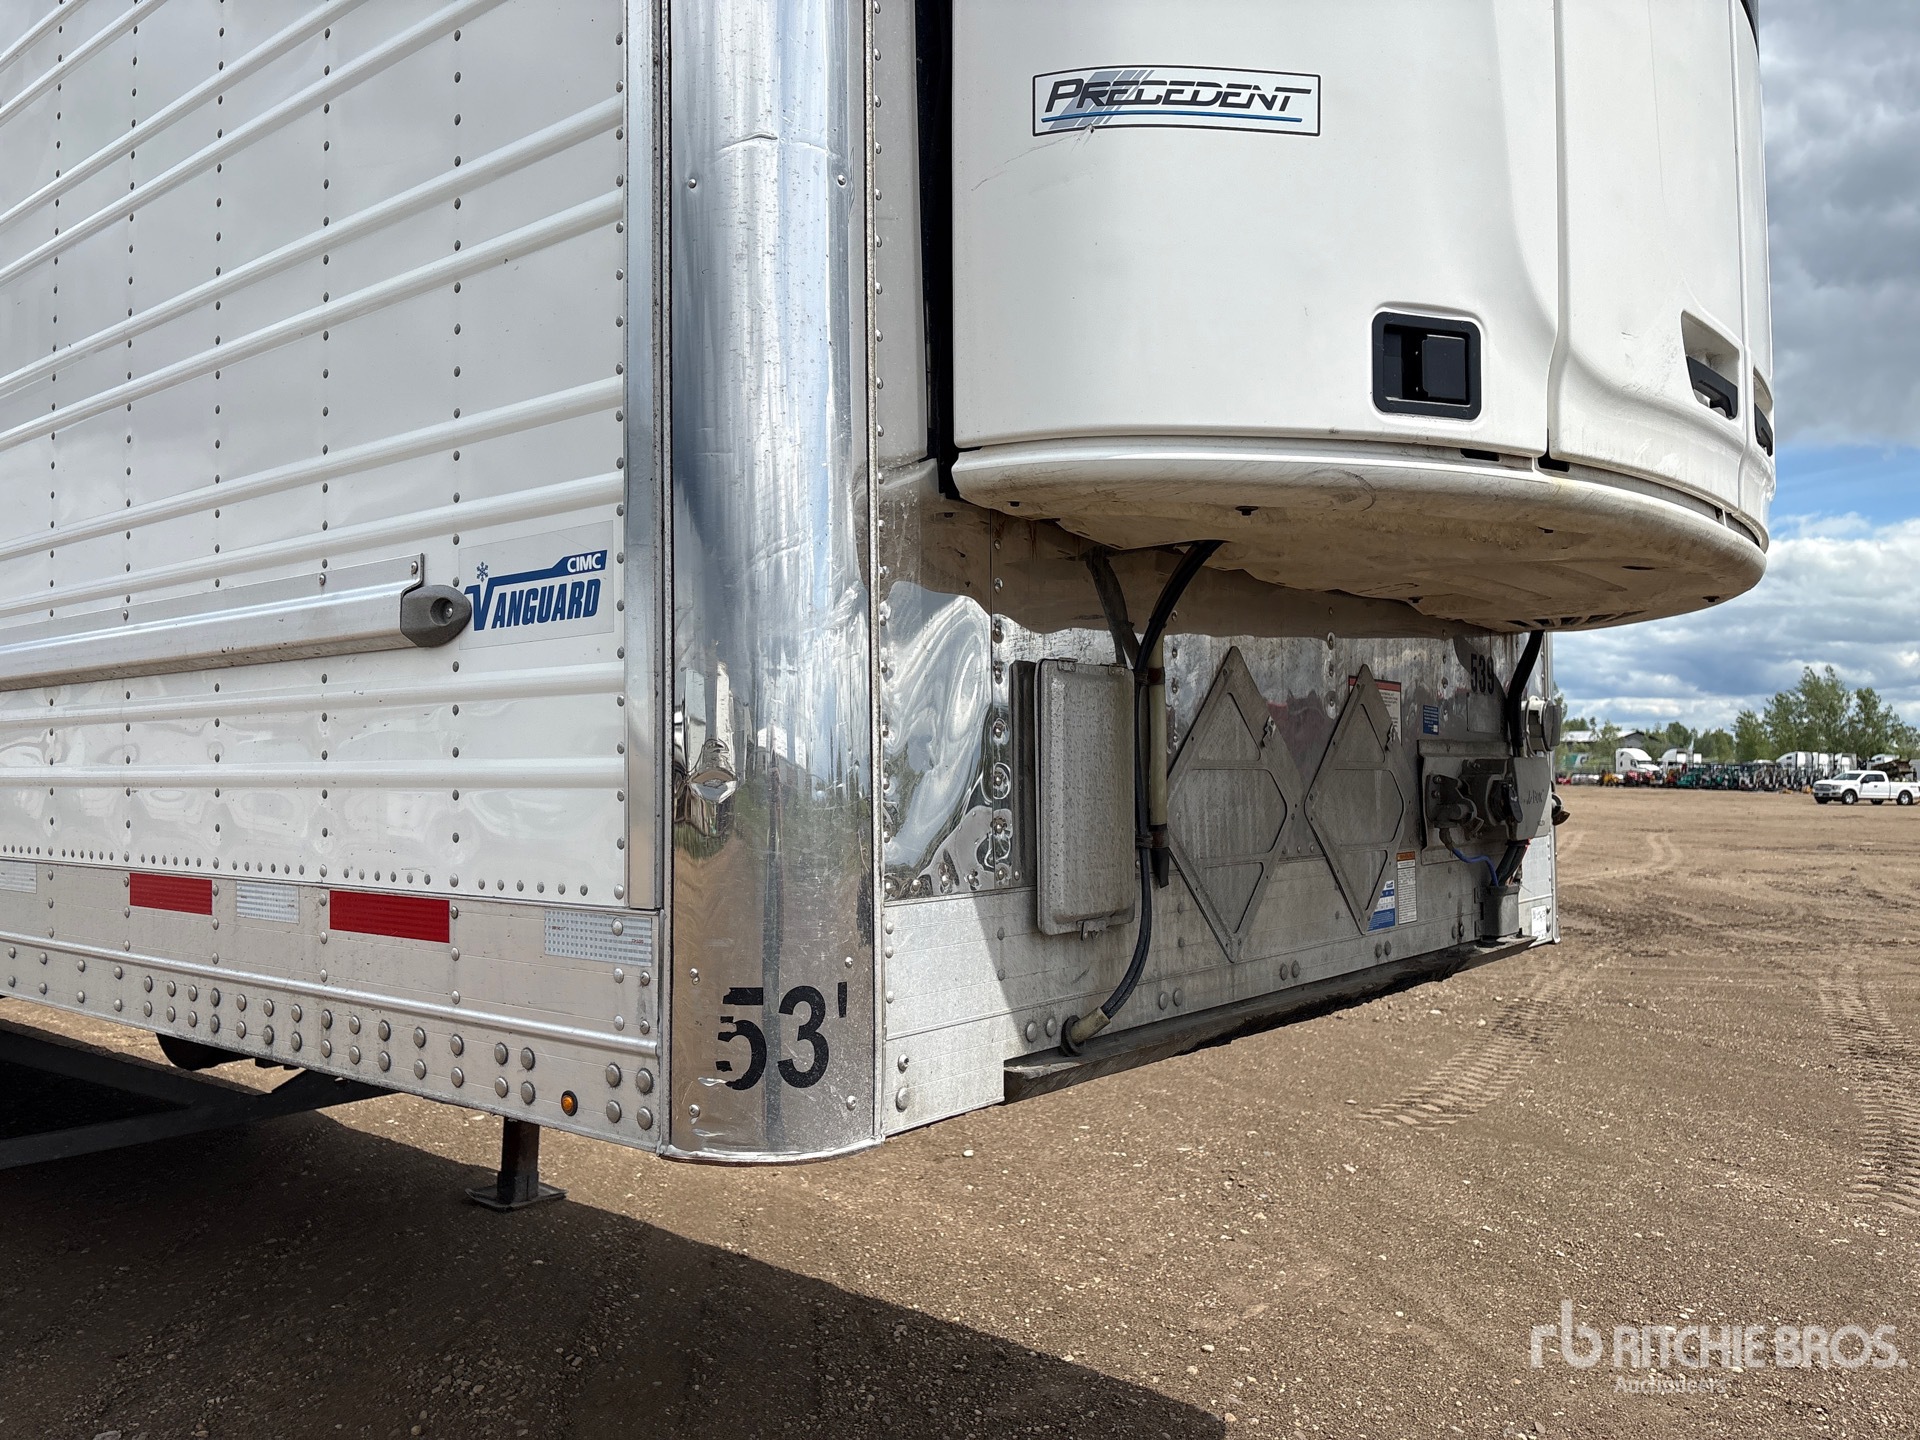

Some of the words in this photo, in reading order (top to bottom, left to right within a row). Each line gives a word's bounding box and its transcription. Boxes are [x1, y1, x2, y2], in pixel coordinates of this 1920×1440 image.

[1045, 79, 1311, 112] PRECEDENT
[567, 553, 601, 573] CIMC
[464, 578, 601, 631] VANGUARD
[1470, 653, 1495, 695] 539
